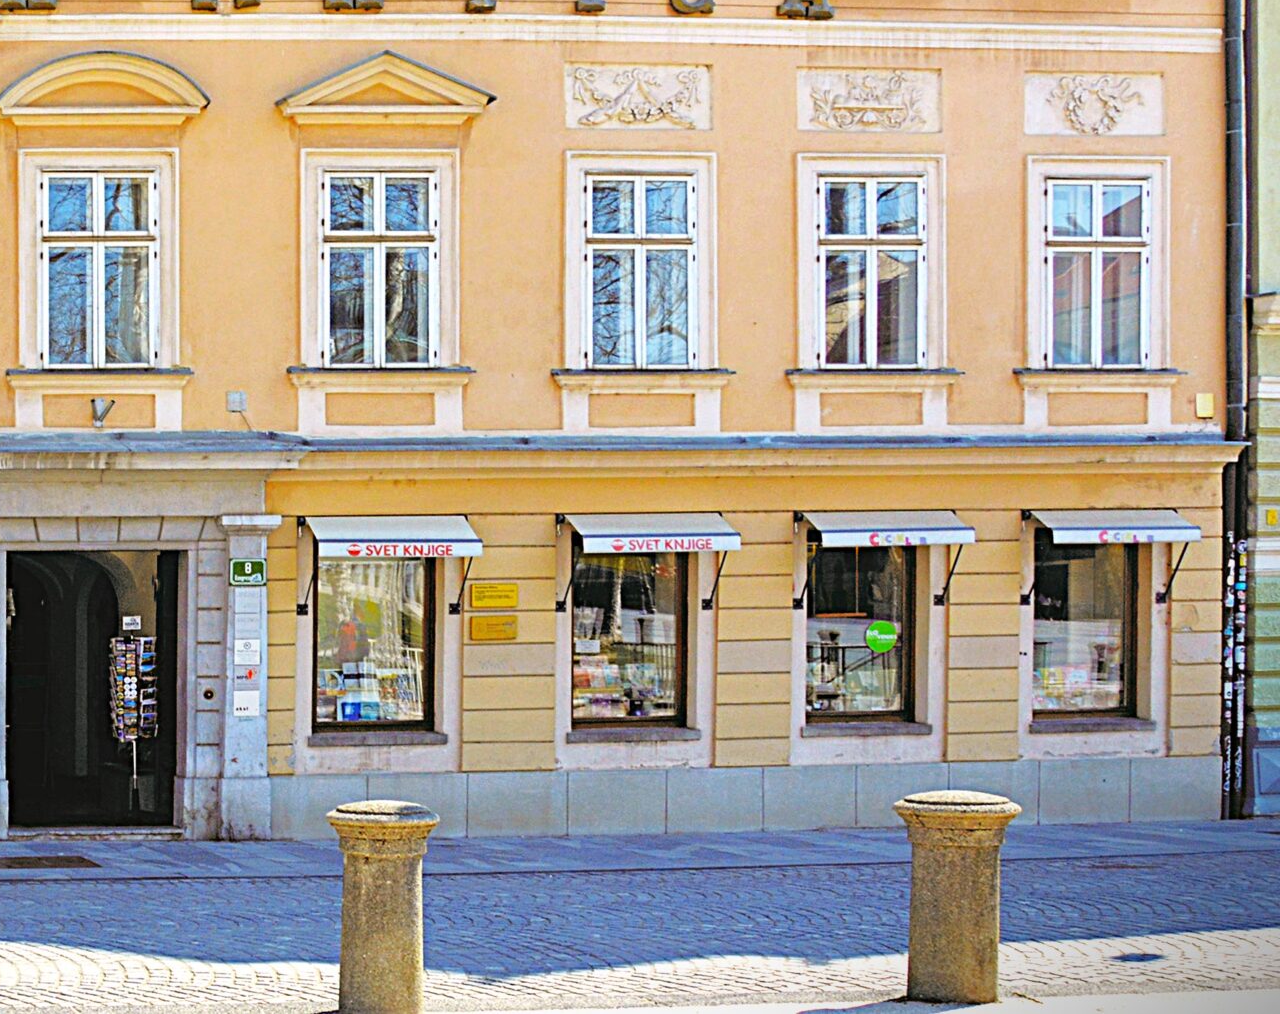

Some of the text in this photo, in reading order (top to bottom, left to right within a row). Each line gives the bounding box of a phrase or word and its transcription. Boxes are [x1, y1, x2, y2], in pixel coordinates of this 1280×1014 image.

[365, 544, 454, 557] SVET KNJIGE
[628, 538, 713, 551] SVET KNJIGE
[244, 561, 252, 575] 8
